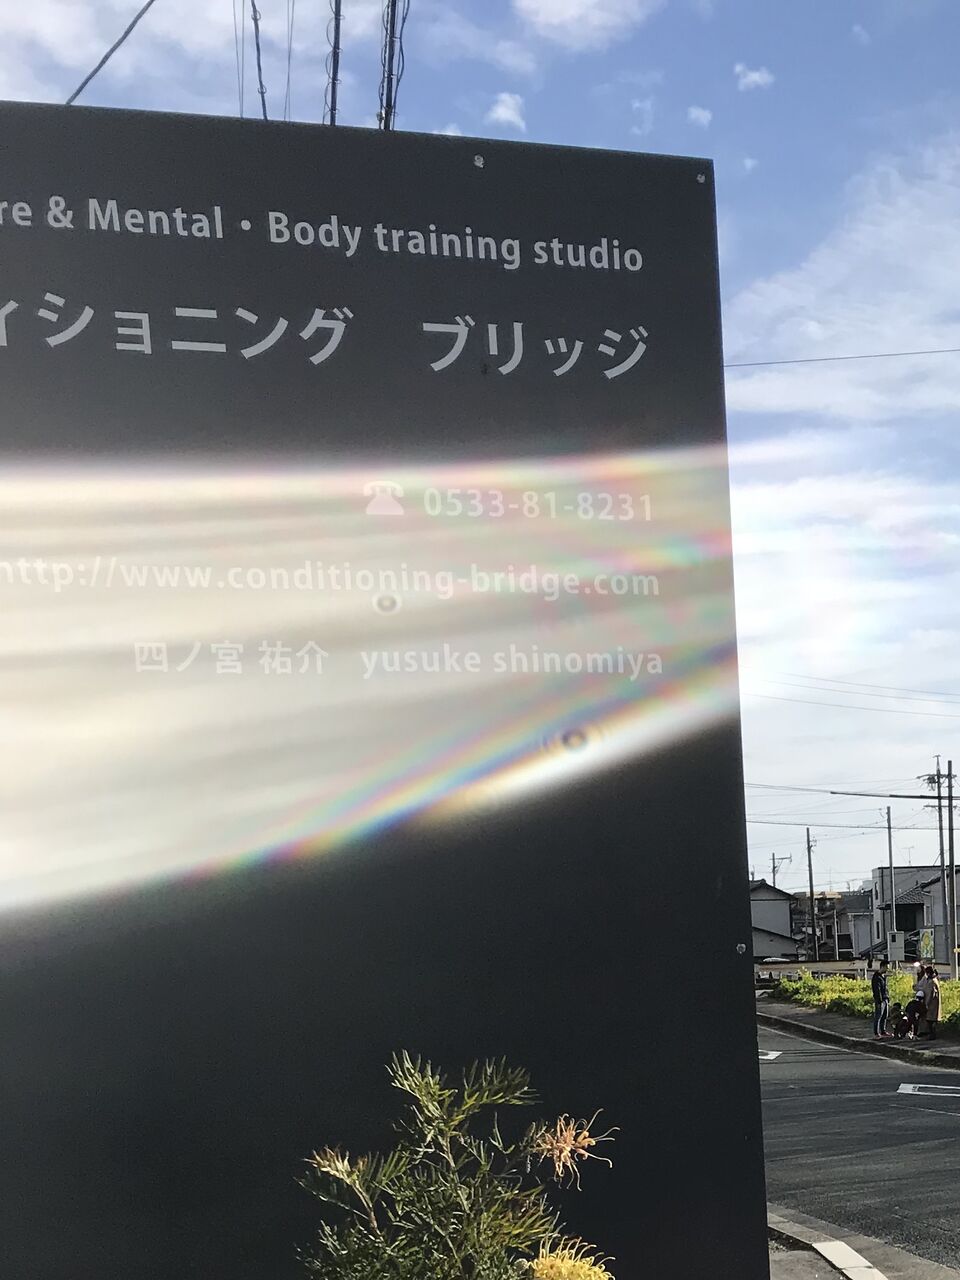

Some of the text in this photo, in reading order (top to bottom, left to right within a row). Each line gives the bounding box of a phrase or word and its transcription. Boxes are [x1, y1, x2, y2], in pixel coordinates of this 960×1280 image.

[47, 195, 75, 229] &
[88, 197, 224, 239] Mental
[268, 211, 362, 258] Body
[374, 223, 521, 270] training
[533, 239, 644, 272] studio
[422, 314, 649, 380] ブリッジ
[423, 487, 653, 521] 0533-81-8231
[360, 643, 482, 680] yusuke
[492, 643, 664, 682] shinomiya
